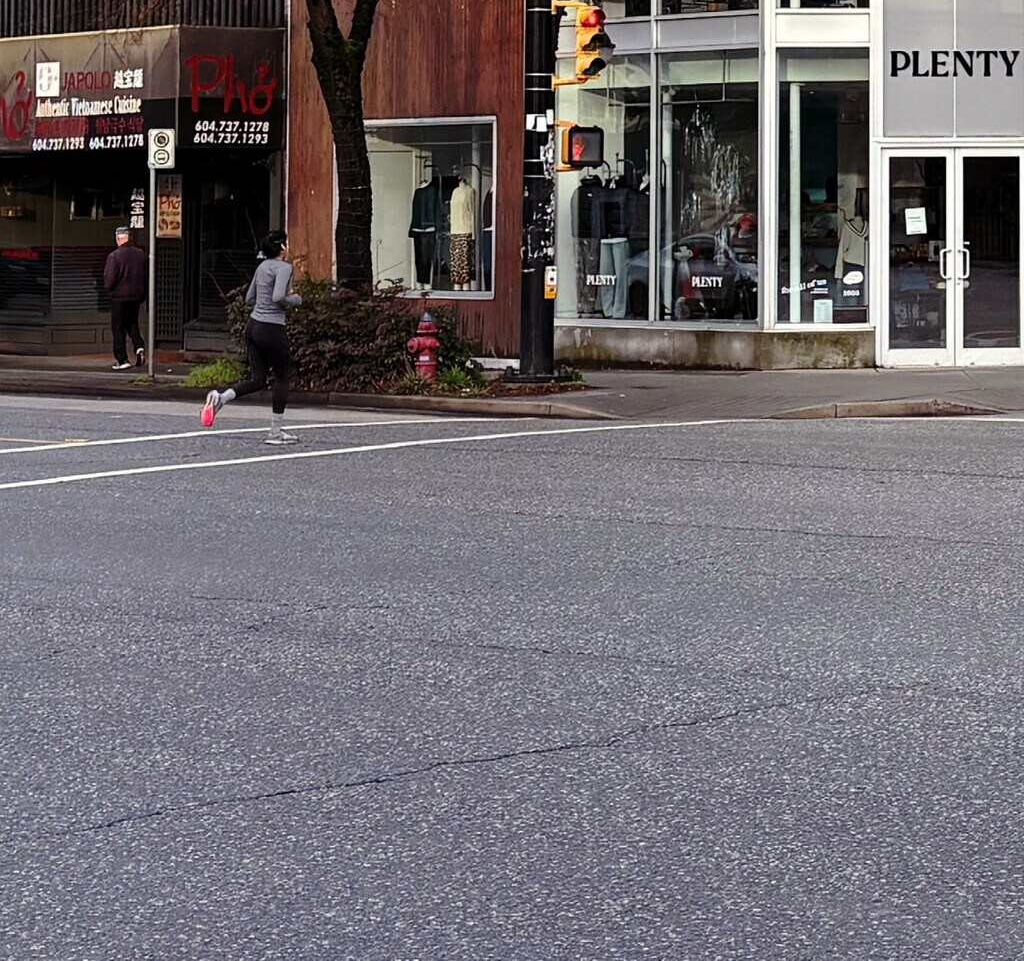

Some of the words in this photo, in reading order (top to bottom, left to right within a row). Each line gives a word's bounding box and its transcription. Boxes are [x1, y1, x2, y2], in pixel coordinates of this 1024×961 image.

[889, 50, 1020, 77] PLENTY
[62, 71, 112, 91] JAPOLO
[35, 98, 70, 118] Authentic
[71, 97, 113, 116] Vietnamese
[113, 94, 141, 114] Cuisine
[195, 120, 270, 133] 604.737.1278
[32, 137, 85, 152] 604.737.1293
[88, 133, 145, 150] 604.737.1278
[193, 134, 269, 145] 604.737.1293
[586, 274, 617, 286] PLENTY
[691, 276, 723, 288] PLENTY
